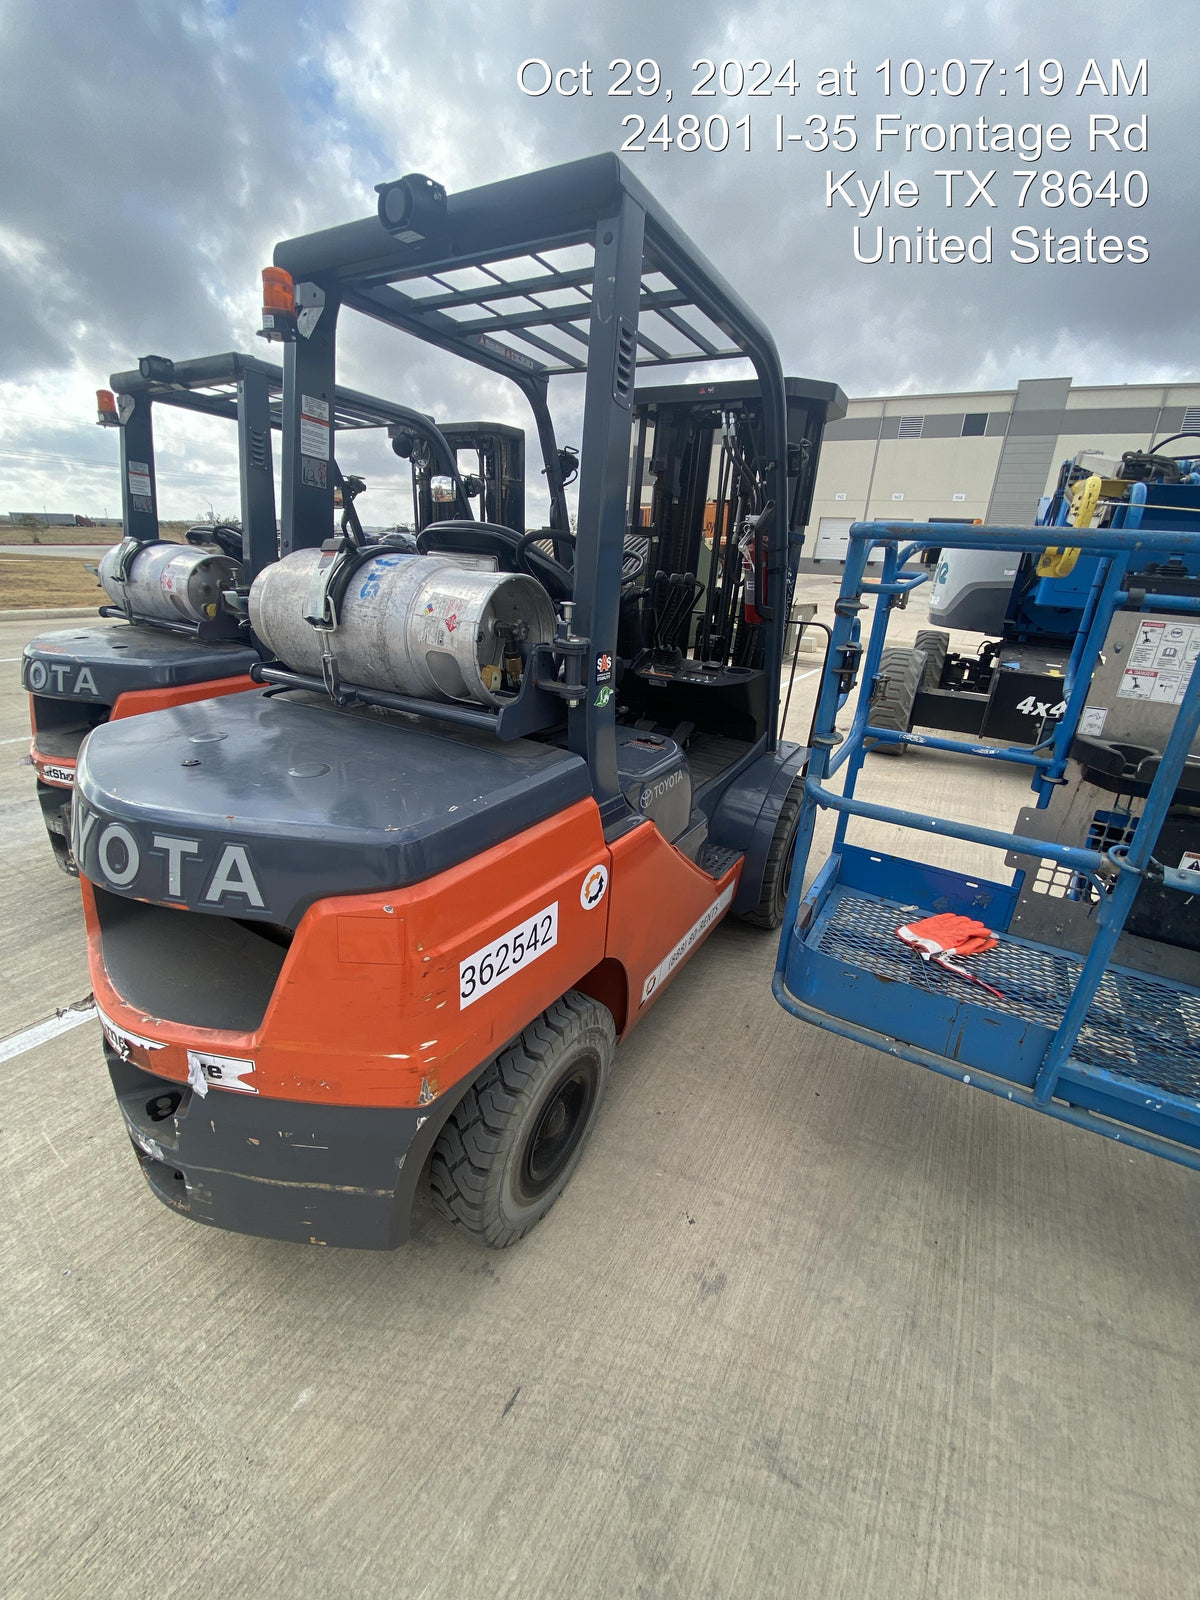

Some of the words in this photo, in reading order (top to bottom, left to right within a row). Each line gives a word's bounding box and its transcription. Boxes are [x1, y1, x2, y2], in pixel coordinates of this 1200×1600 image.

[24, 659, 99, 695] OTA
[596, 654, 612, 673] SAS
[1016, 695, 1068, 718] 4x4
[653, 769, 684, 799] TOYOTA
[71, 802, 265, 907] YOTA
[461, 914, 553, 999] 362542
